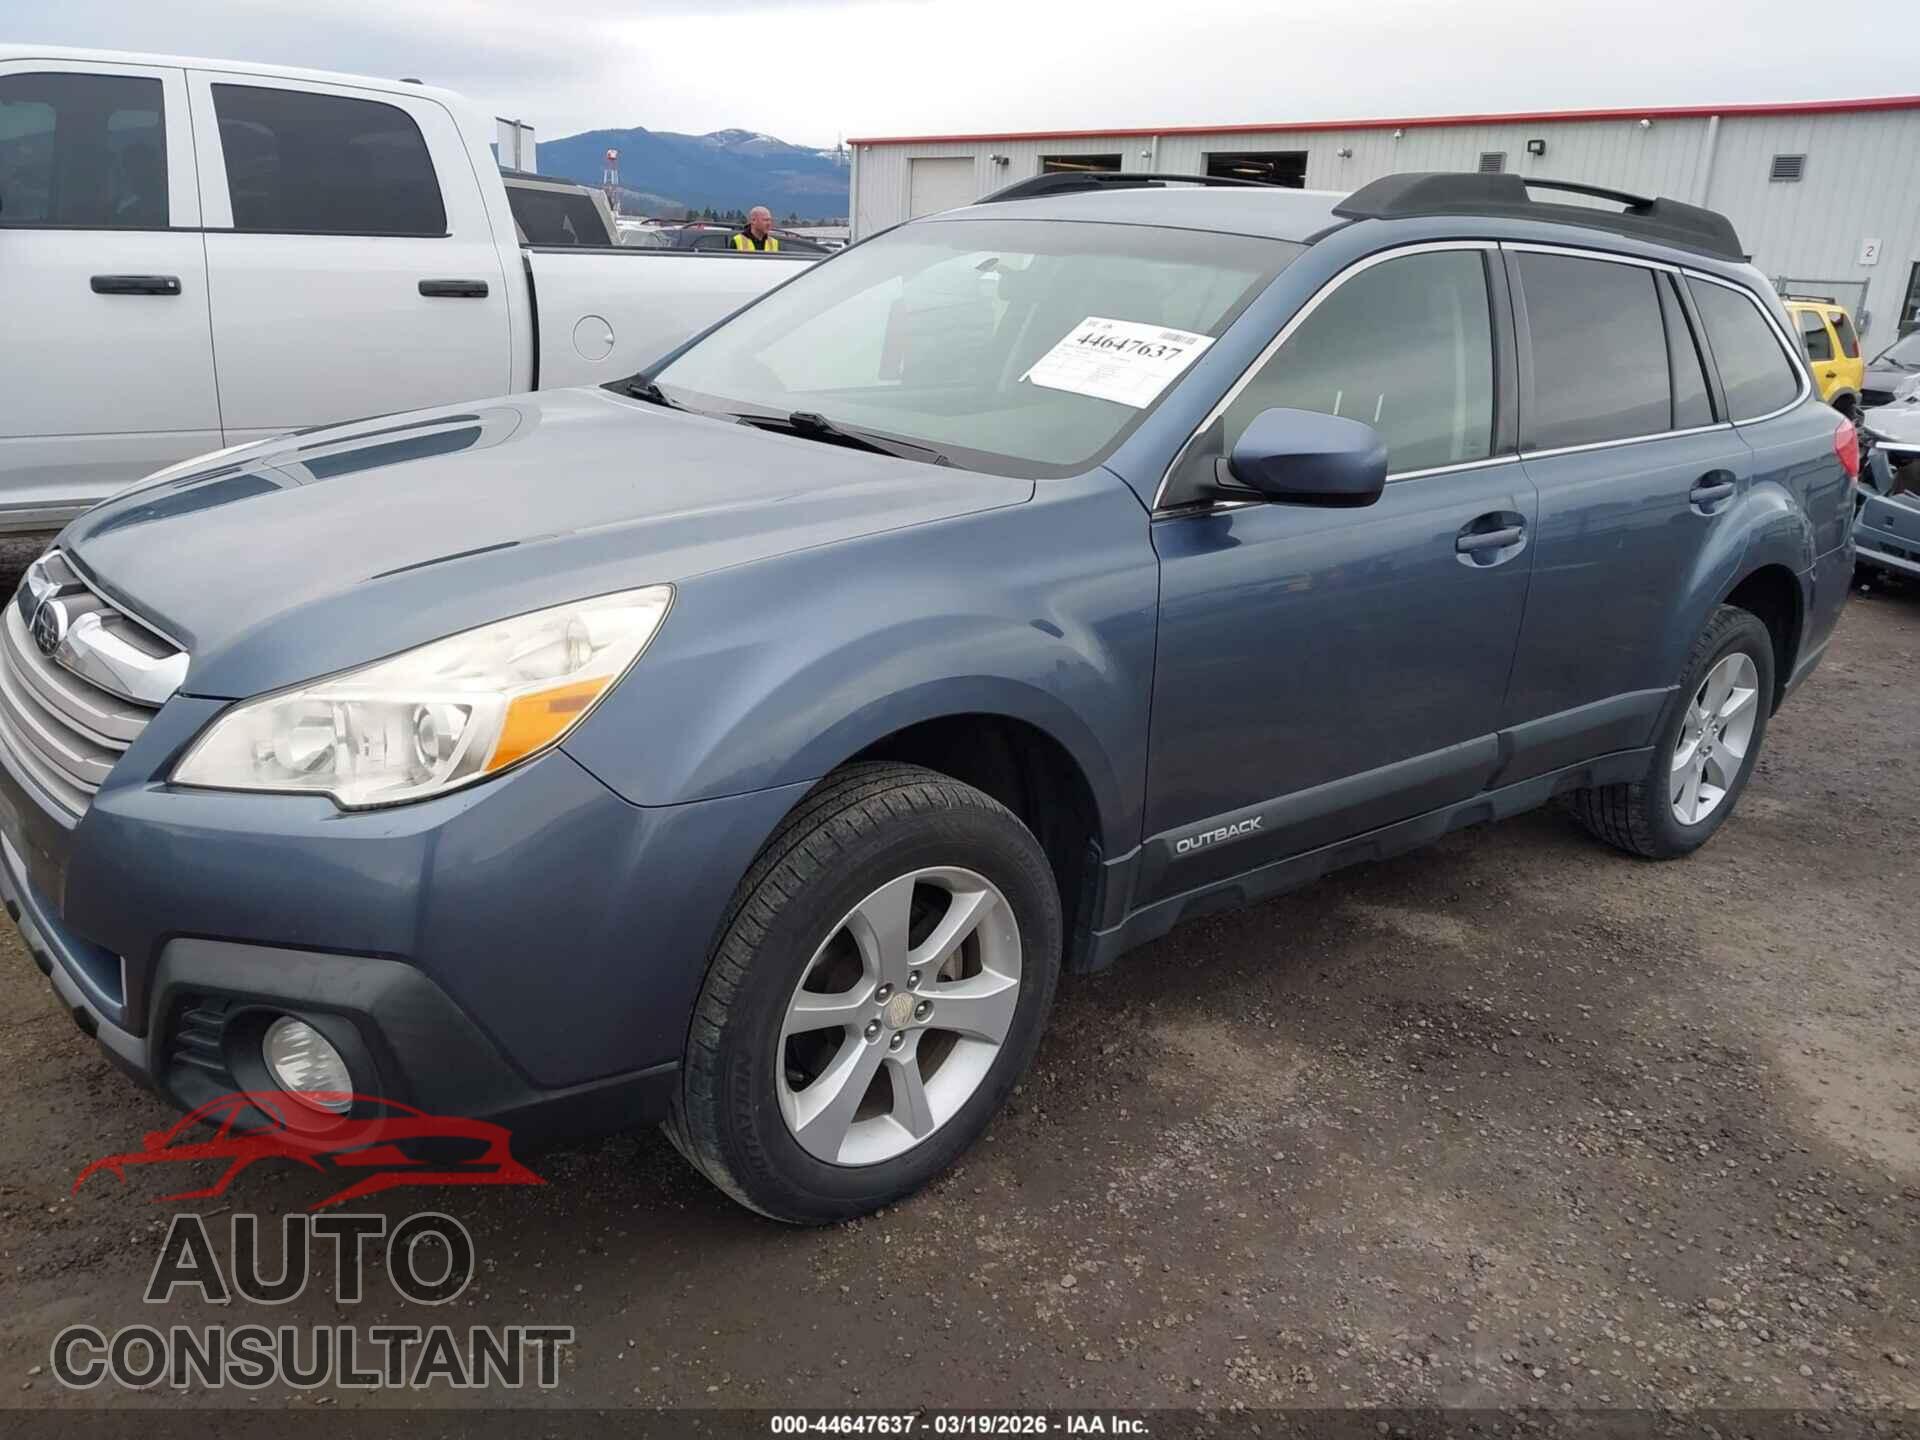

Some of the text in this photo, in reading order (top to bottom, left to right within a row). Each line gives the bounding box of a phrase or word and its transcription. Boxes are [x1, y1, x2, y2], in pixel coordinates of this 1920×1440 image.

[1865, 246, 1875, 257] 2
[1076, 332, 1183, 361] 44647637
[1176, 816, 1262, 853] OUTBACK
